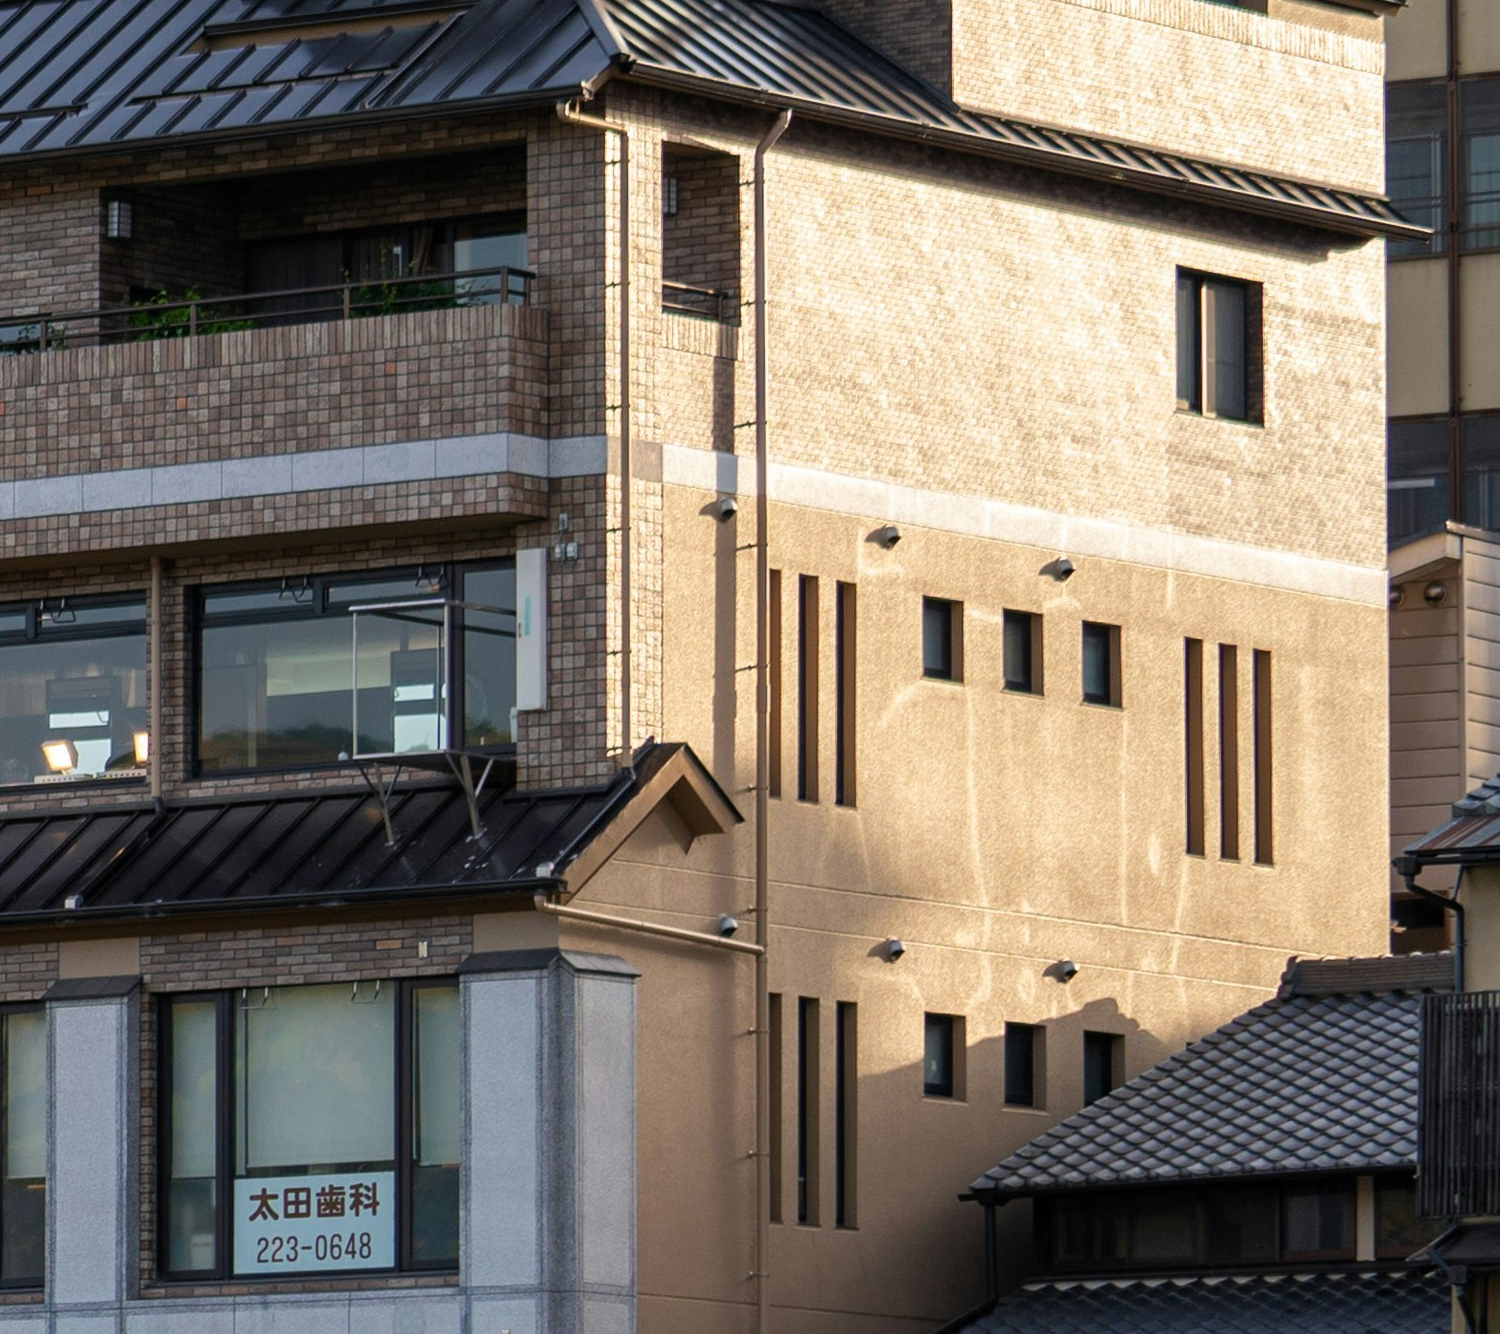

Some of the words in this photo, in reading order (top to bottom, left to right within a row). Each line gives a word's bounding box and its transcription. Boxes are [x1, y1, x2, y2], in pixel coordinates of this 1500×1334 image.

[248, 1182, 380, 1222] 太田歯科
[256, 1231, 372, 1264] 223-0648
